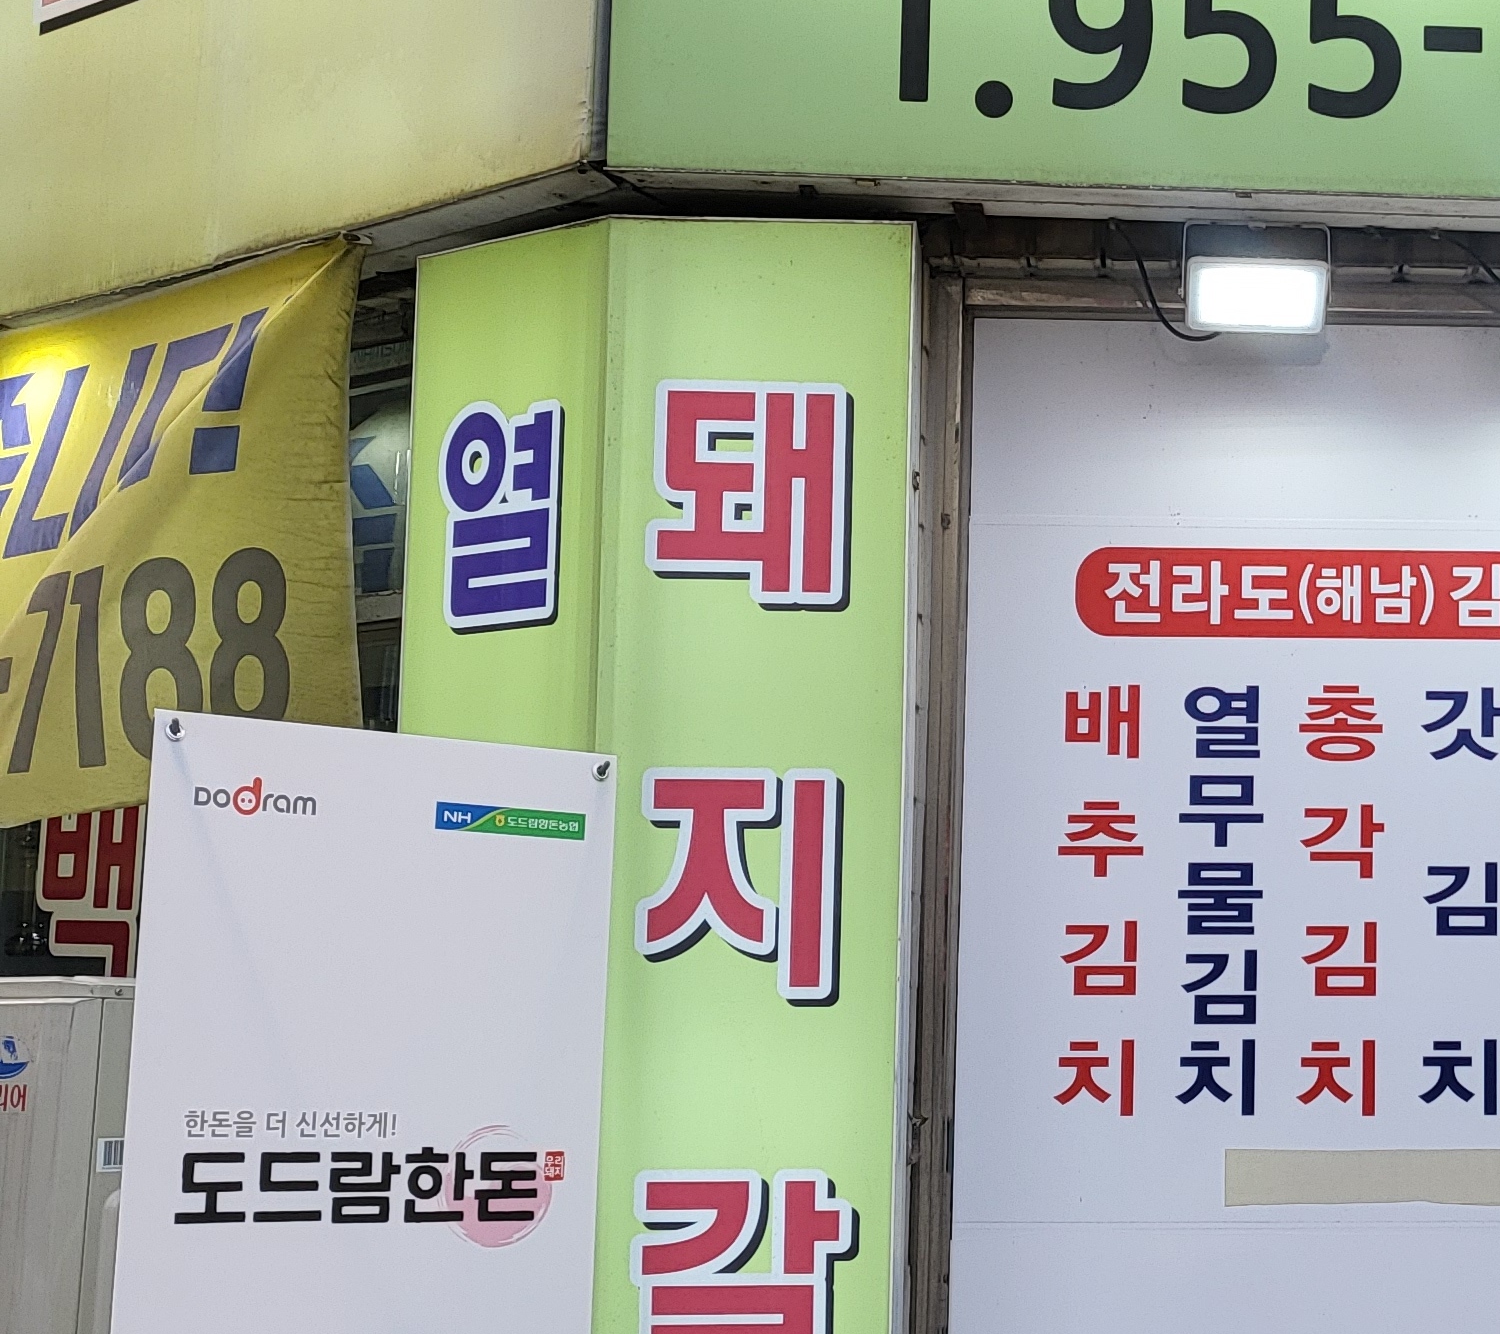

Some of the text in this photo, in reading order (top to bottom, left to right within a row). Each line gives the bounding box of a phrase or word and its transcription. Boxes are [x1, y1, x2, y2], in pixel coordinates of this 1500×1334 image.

[1103, 560, 1435, 626] 전라도(해남)
[443, 810, 472, 824] NH
[1053, 684, 1144, 1117] 배추김치
[1175, 684, 1264, 1117] 열무물김치
[1295, 684, 1385, 1117] 총각김치
[183, 1110, 398, 1139] 한돈을 더 신선하게!
[174, 1146, 539, 1225] 도드람한돈
